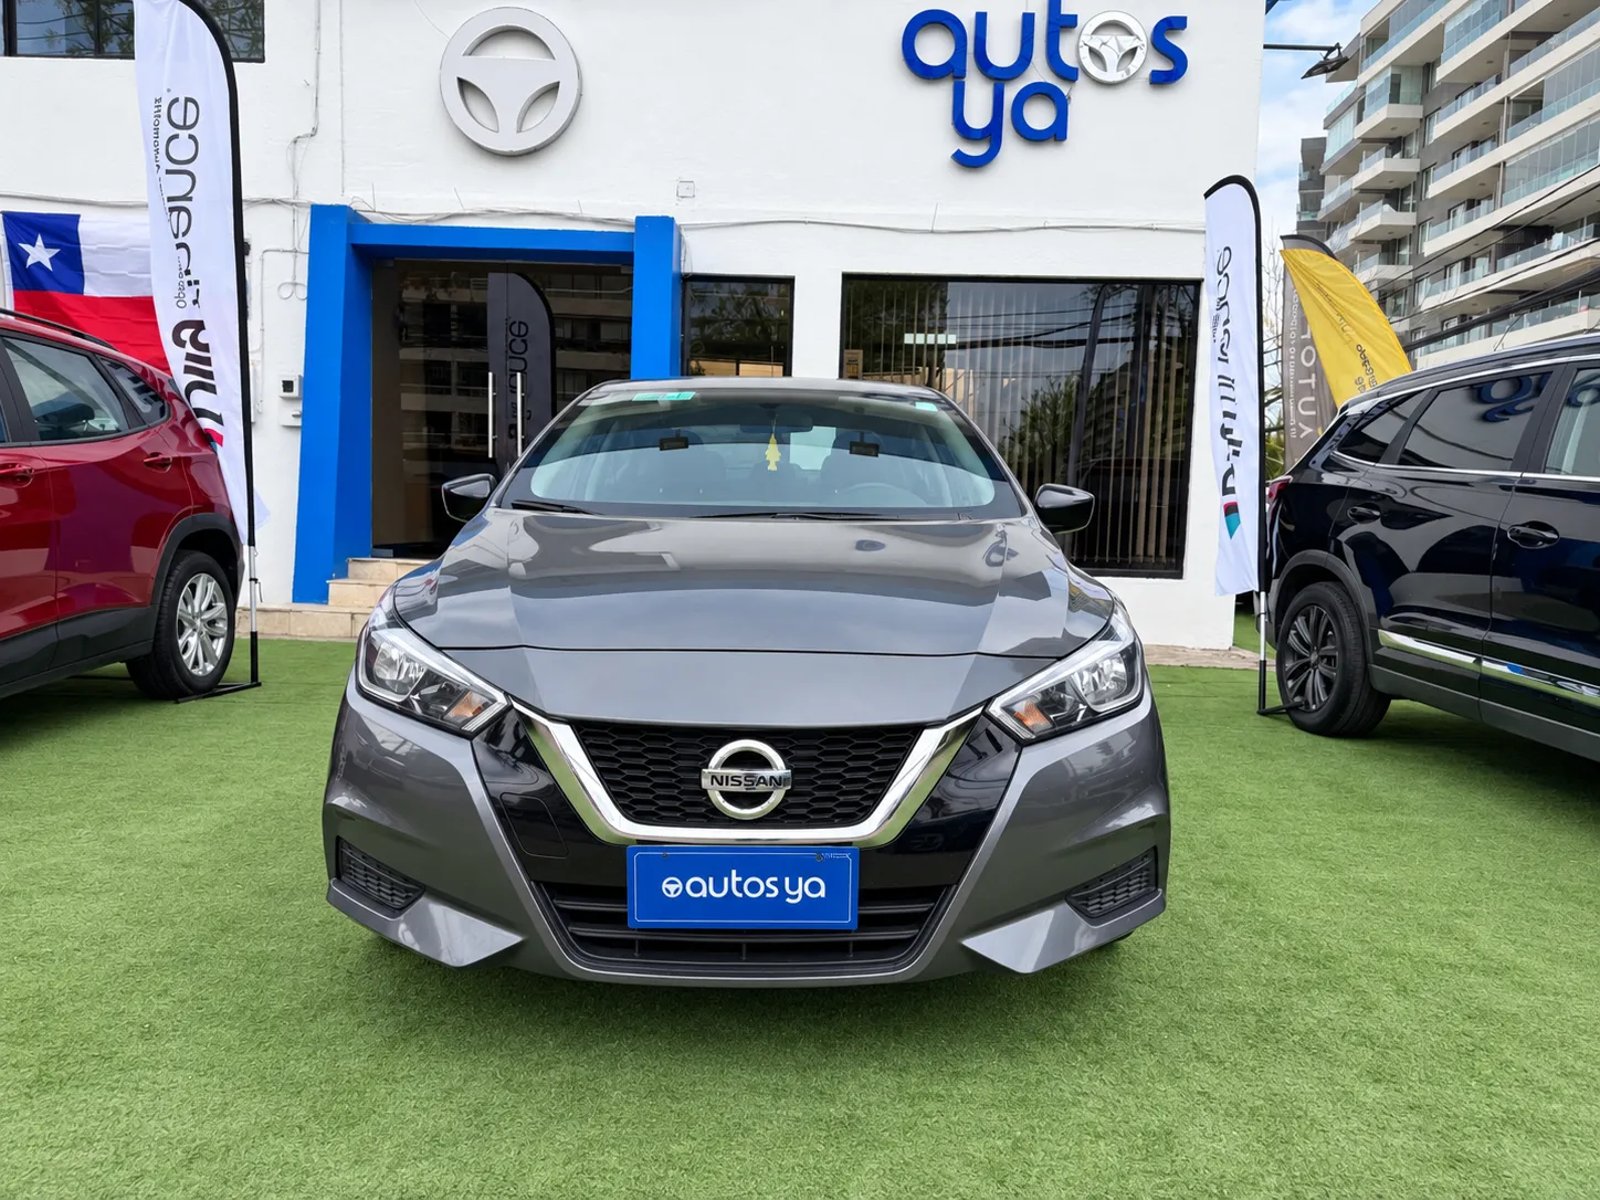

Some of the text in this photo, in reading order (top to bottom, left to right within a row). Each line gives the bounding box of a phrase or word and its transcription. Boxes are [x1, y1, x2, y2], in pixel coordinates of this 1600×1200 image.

[902, 0, 1188, 85] autos
[950, 80, 1069, 168] ya
[710, 775, 783, 787] NISSAN
[685, 869, 826, 904] autos ya
